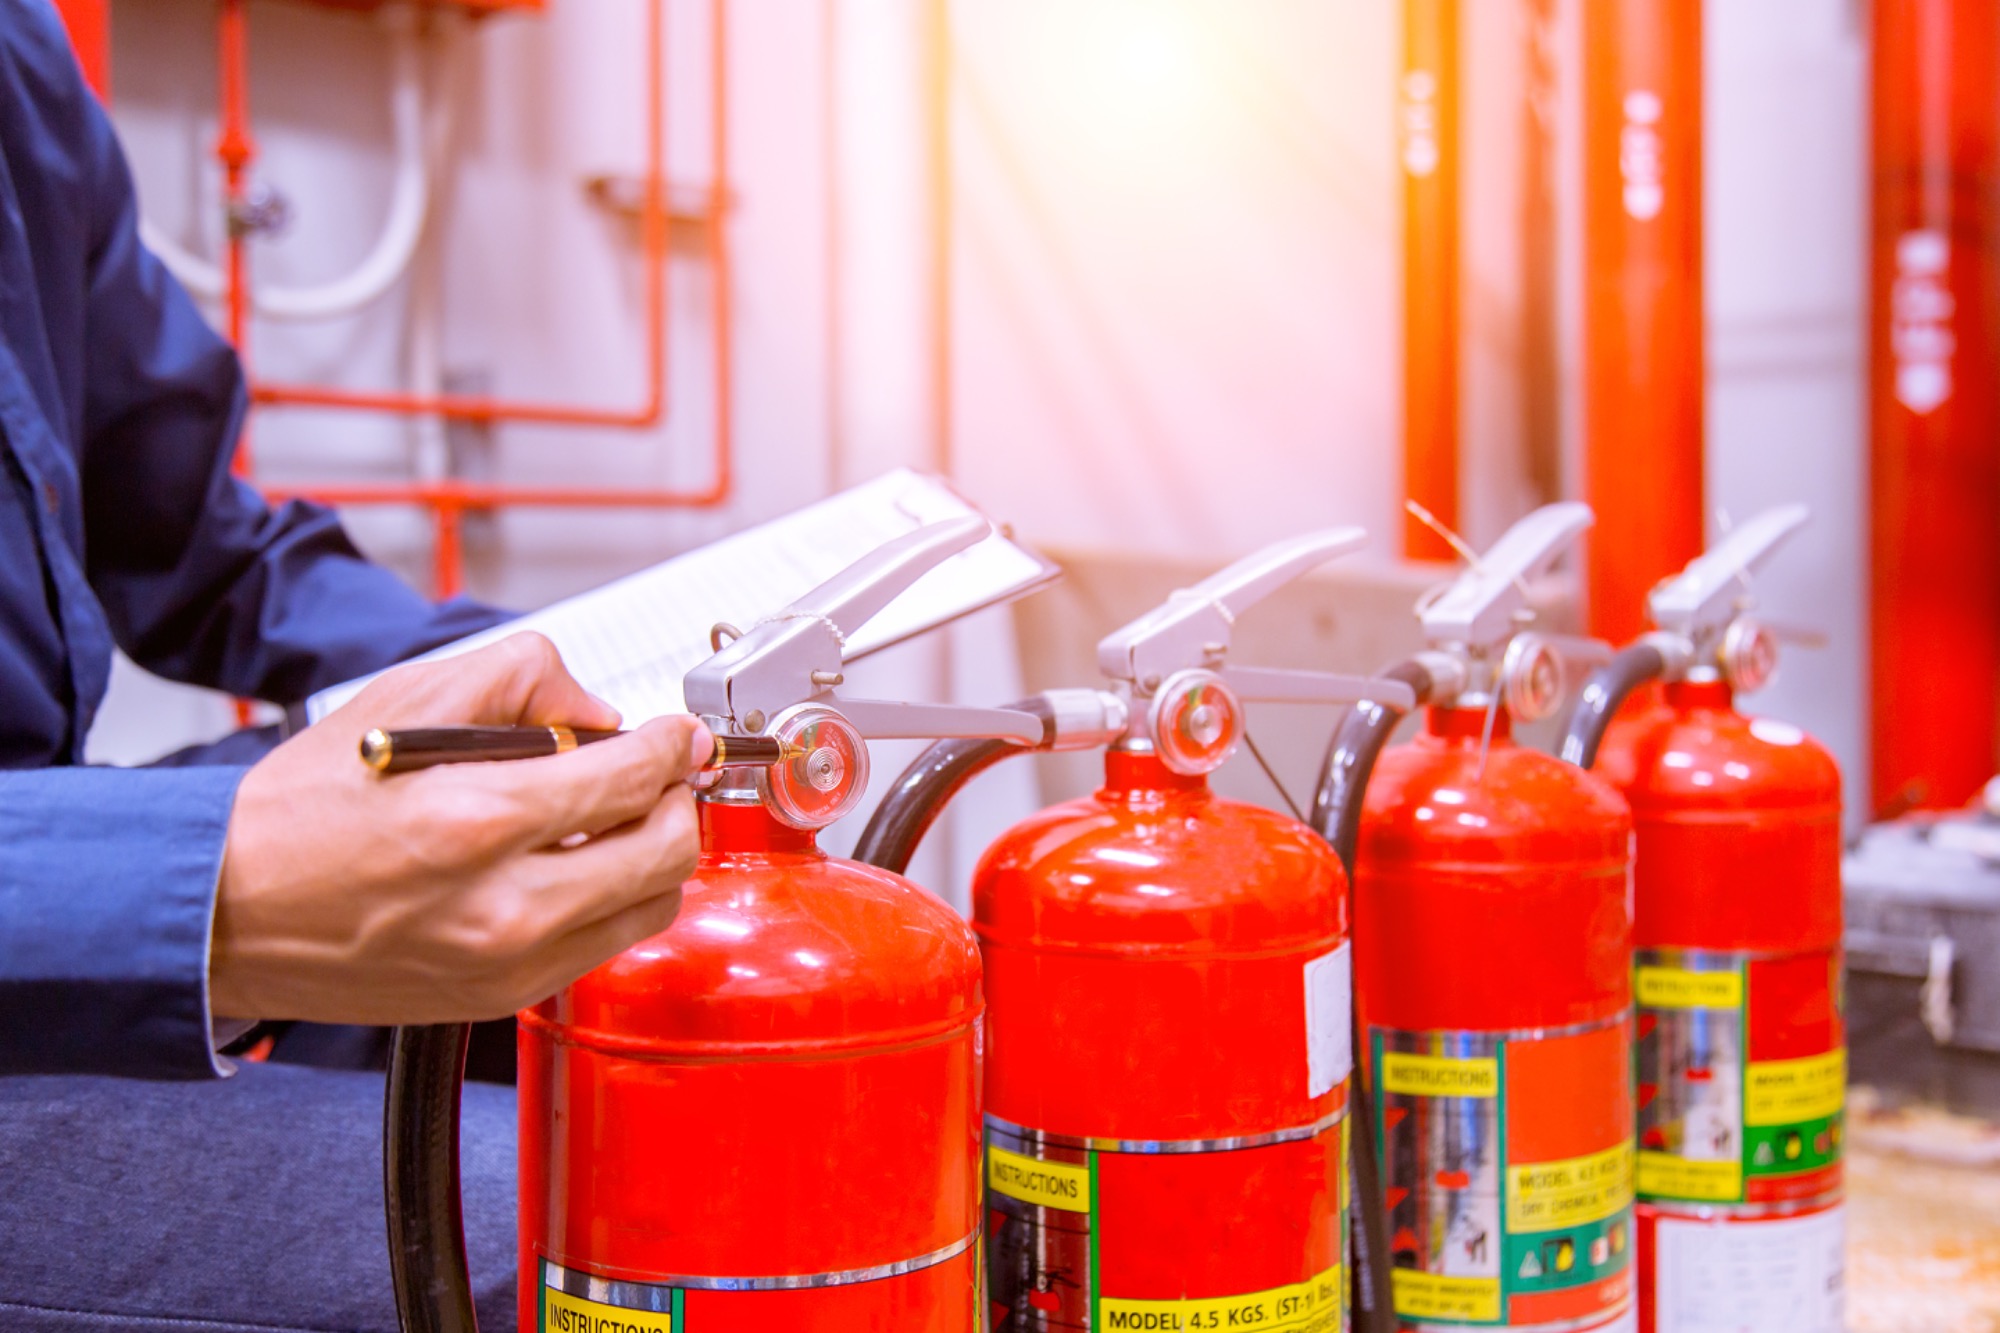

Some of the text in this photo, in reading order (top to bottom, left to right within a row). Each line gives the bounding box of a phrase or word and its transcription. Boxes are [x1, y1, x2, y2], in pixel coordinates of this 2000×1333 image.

[993, 1160, 1078, 1199] INSTRUCTIONS
[550, 1302, 664, 1333] INSTRUCT
[1108, 1311, 1182, 1331] MODEL
[1189, 1311, 1220, 1330] 4.5
[1228, 1304, 1269, 1327] KGS.
